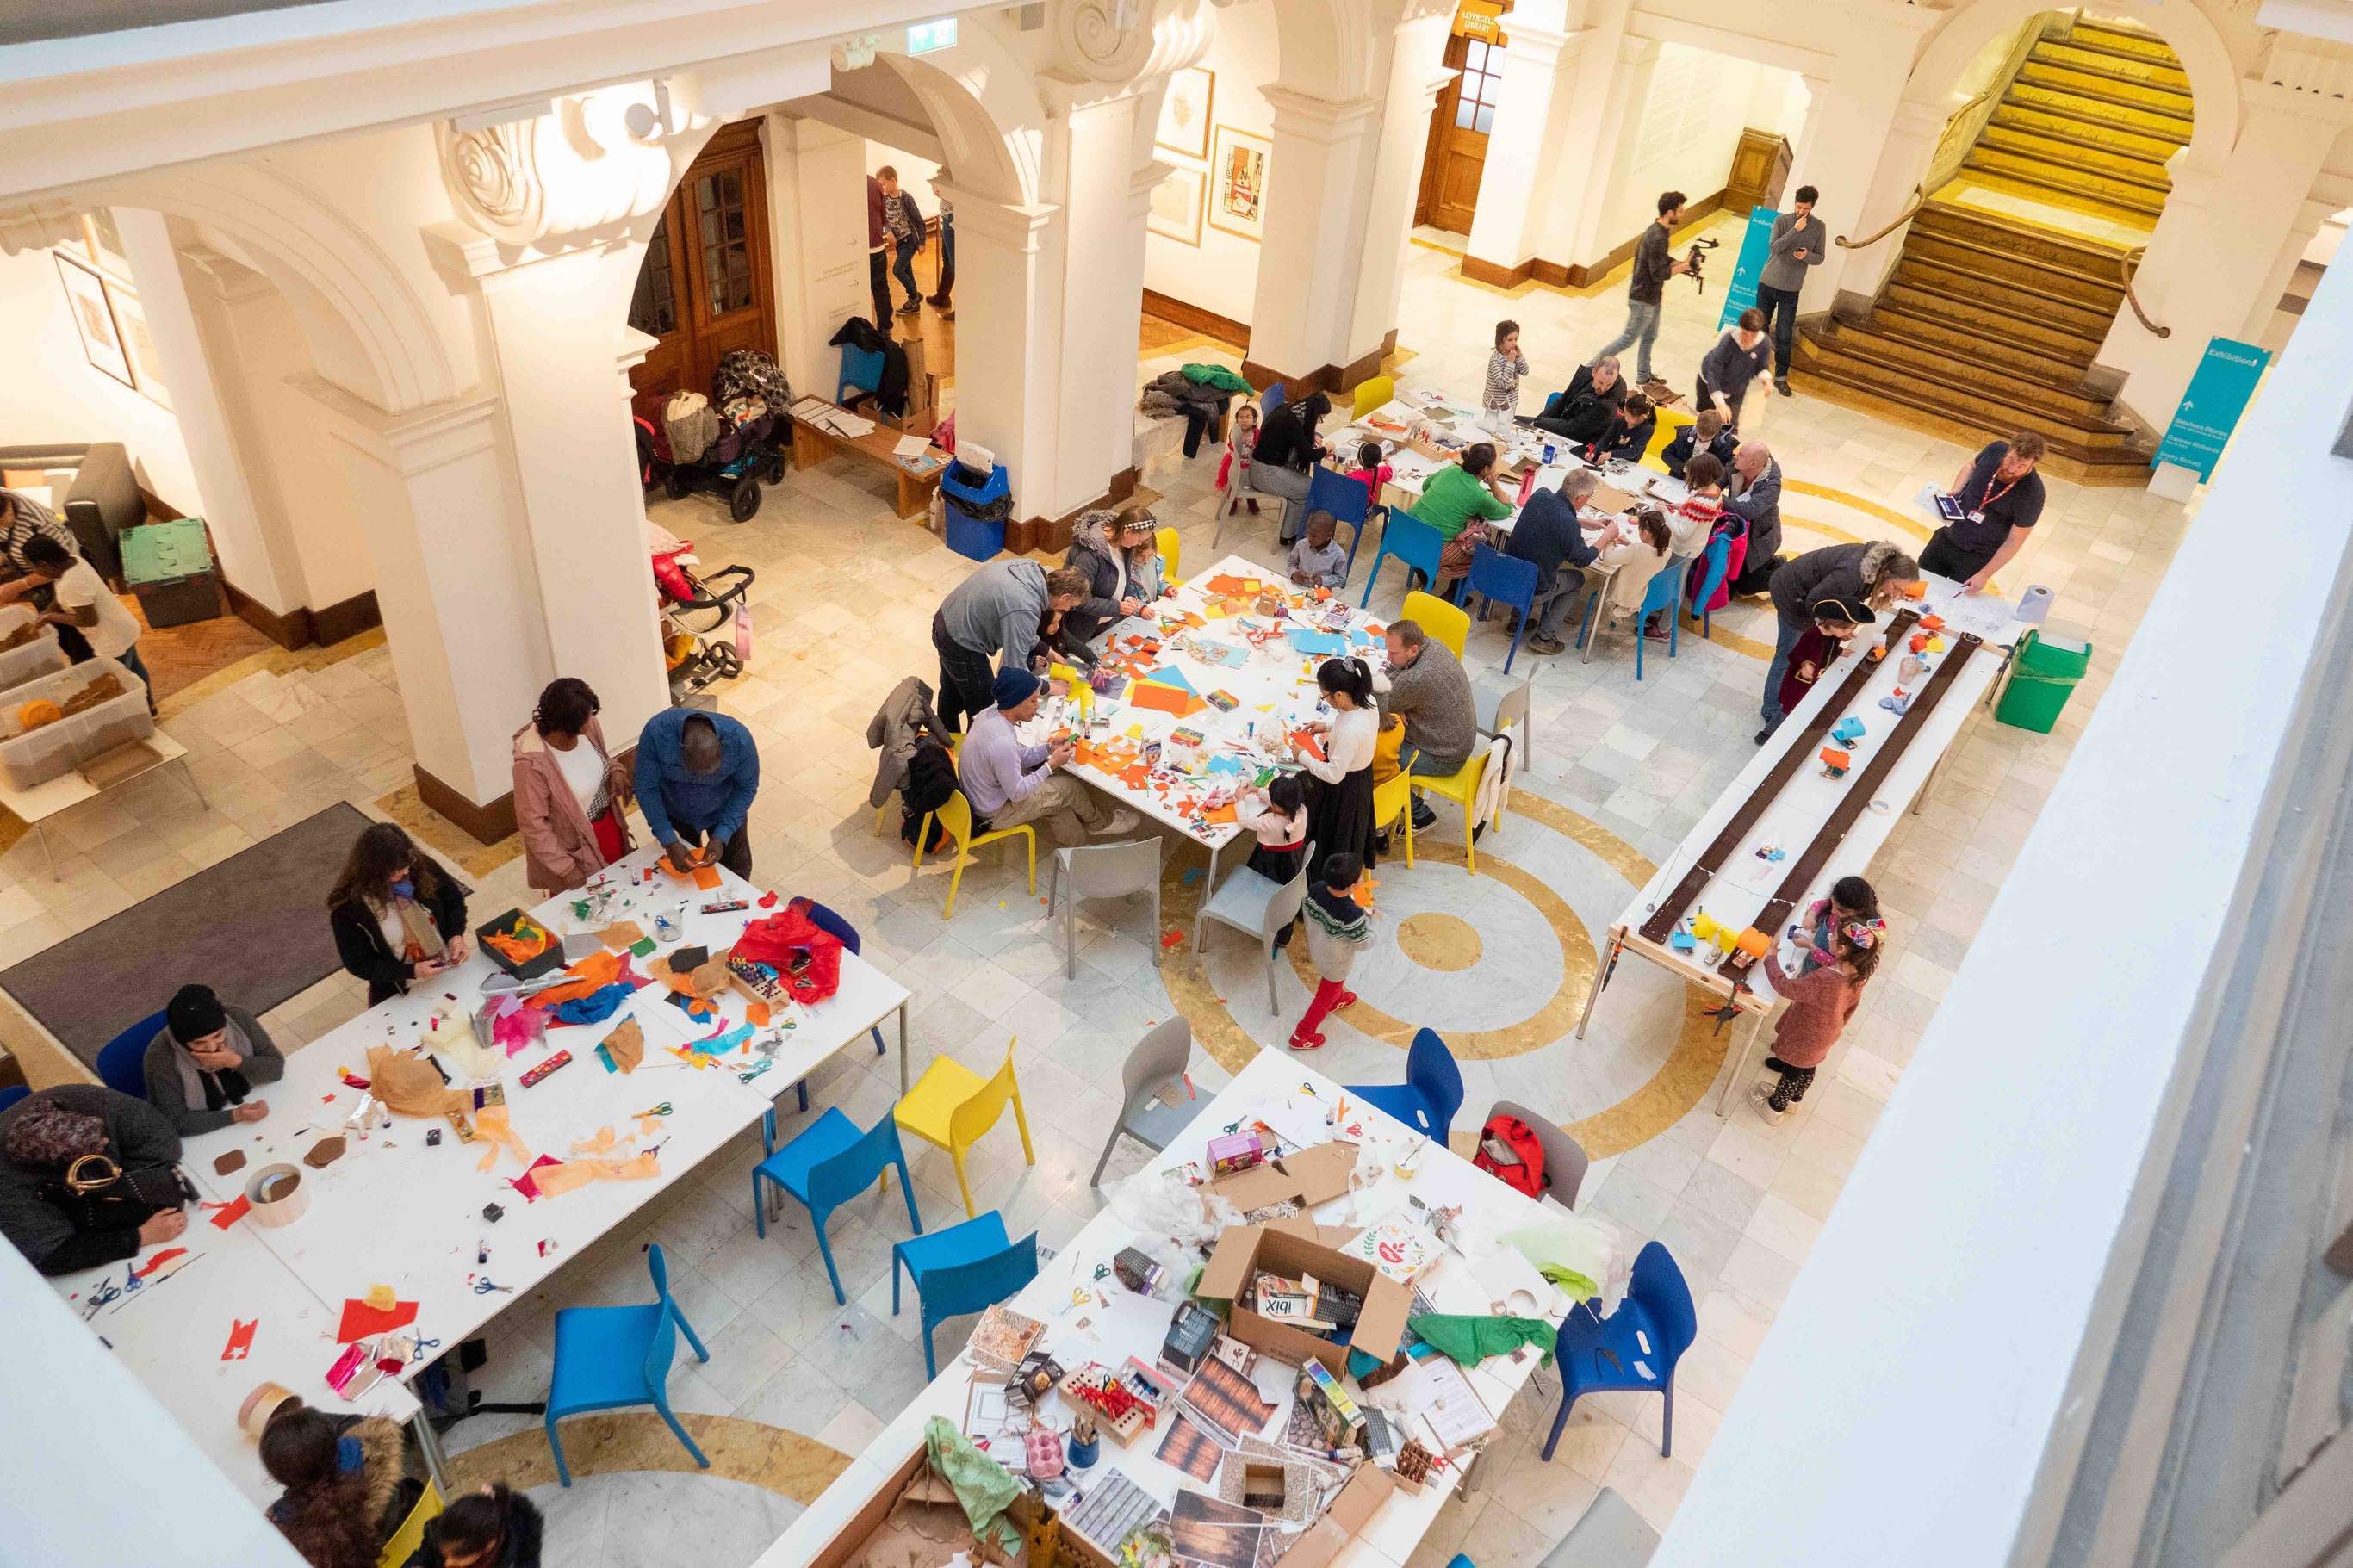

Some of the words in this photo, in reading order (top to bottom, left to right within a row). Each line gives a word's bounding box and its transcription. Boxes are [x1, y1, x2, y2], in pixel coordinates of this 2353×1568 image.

[1464, 21, 1489, 33] LIBRARY
[2208, 348, 2258, 368] Exhibition
[1267, 1298, 1292, 1315] ibix
